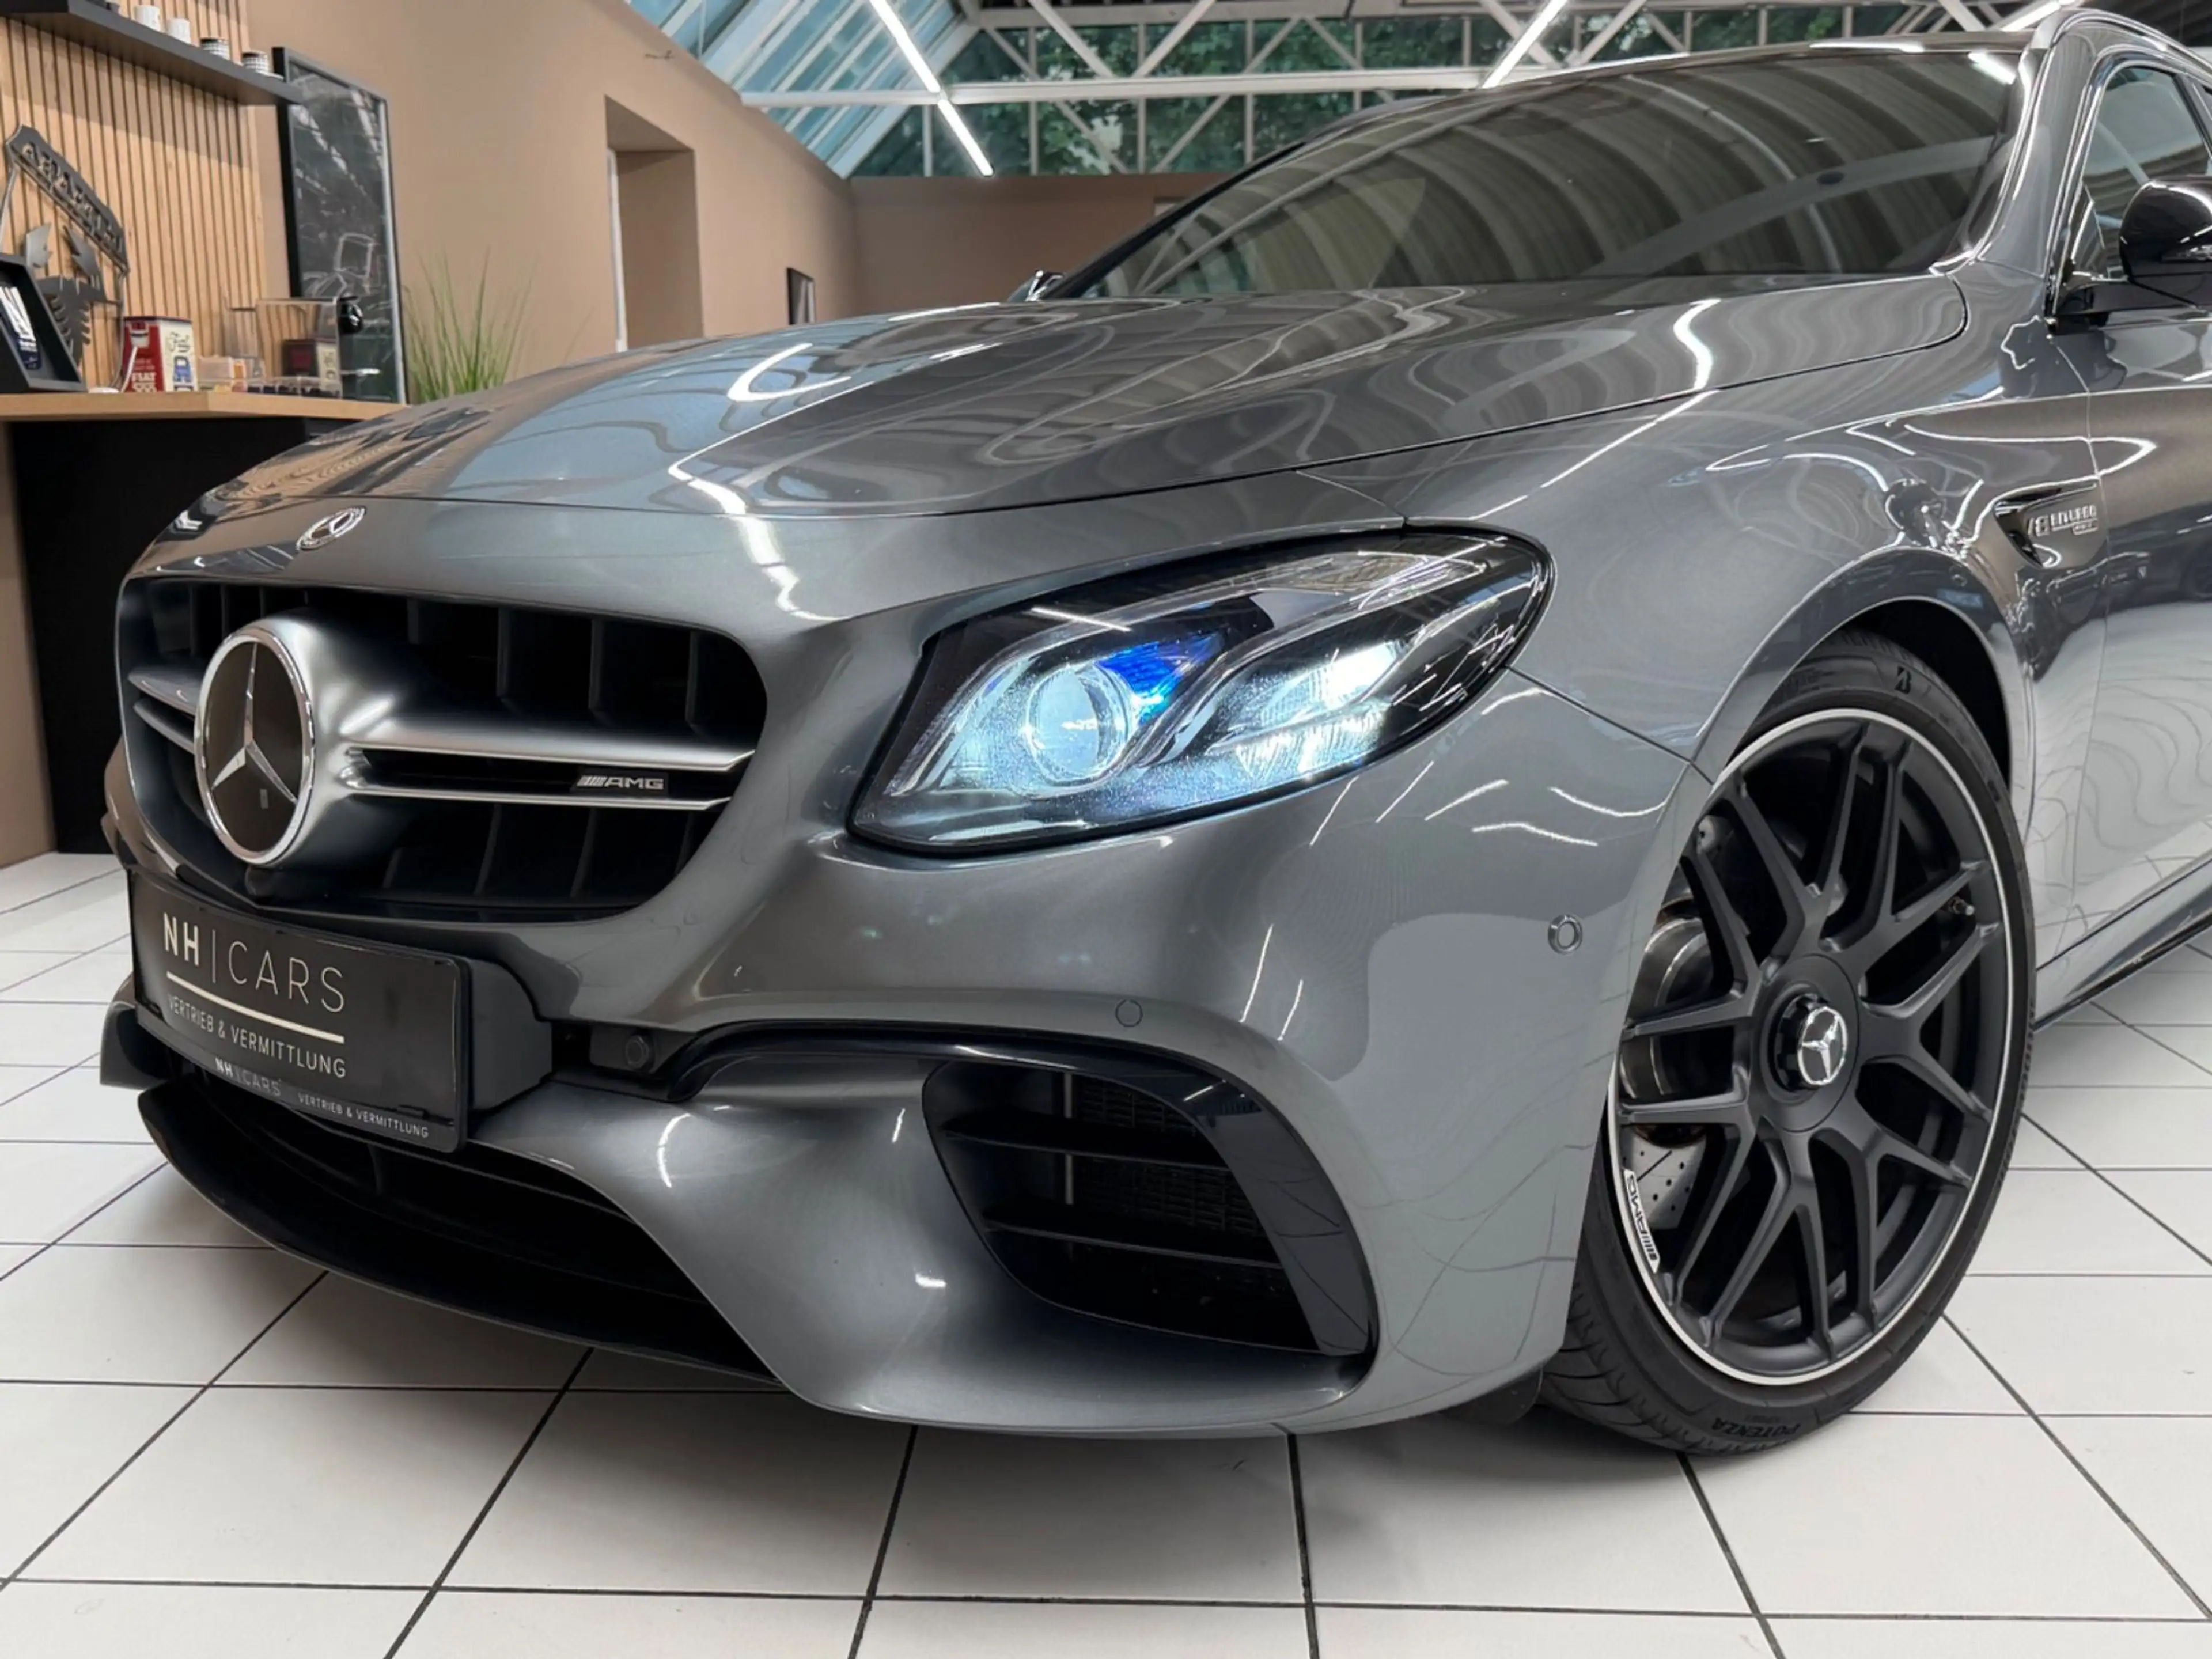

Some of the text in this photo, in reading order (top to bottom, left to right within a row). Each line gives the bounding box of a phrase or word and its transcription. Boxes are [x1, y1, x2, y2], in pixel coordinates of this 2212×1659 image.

[604, 775, 664, 789] AMG
[228, 940, 344, 1013] CARS
[167, 994, 346, 1078] VERTRIEB & VERMITTLUNG
[298, 1093, 343, 1115] VERTRIEB
[347, 1107, 353, 1118] &
[356, 1108, 429, 1138] VERMITTLUNG
[1711, 1417, 1801, 1438] POTENZA
